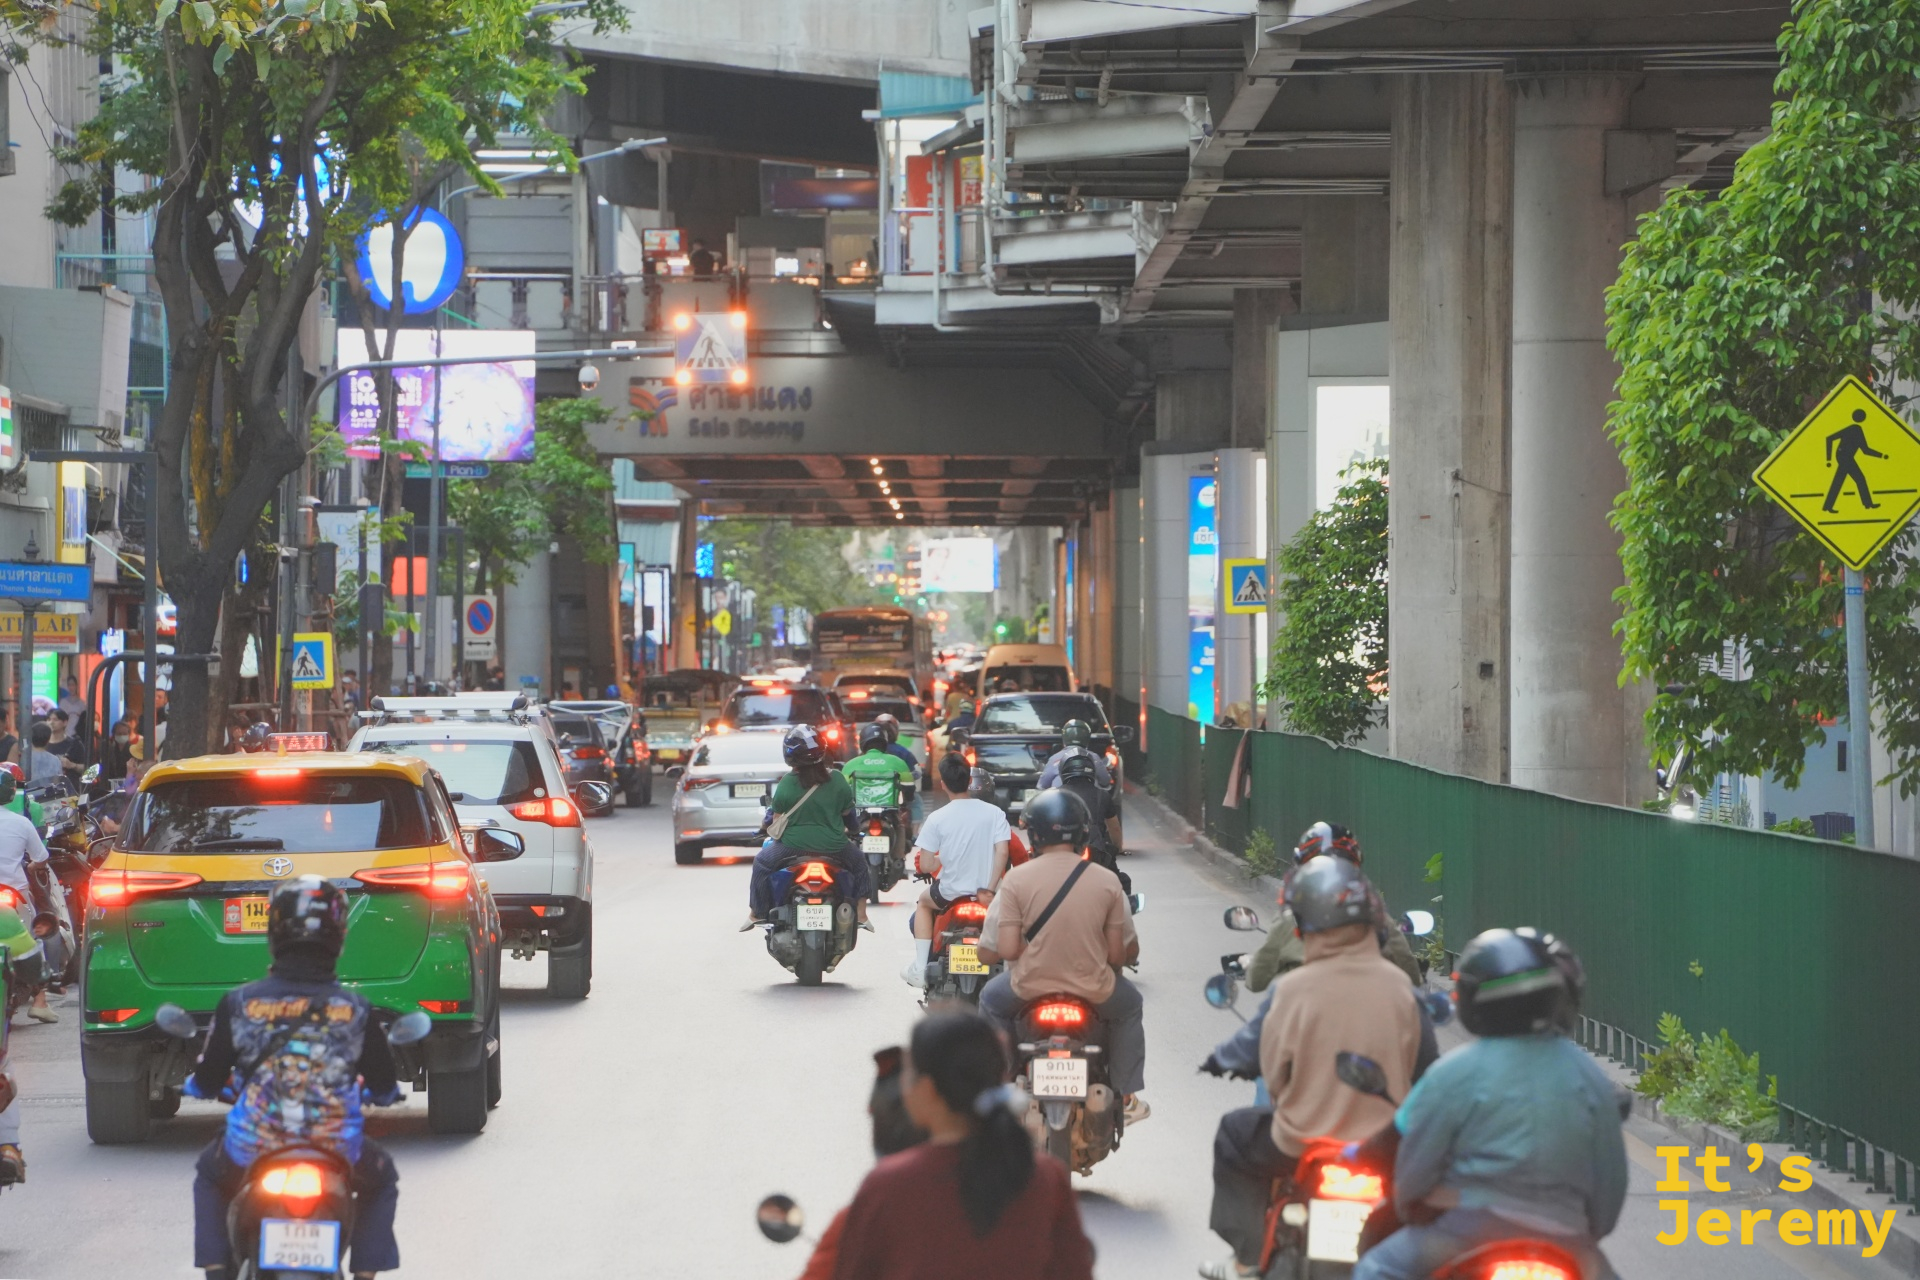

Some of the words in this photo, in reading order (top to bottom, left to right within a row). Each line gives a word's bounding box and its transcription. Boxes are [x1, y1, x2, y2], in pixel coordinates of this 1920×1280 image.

[274, 735, 324, 750] TAXI
[863, 757, 887, 766] Grab
[806, 920, 824, 928] 654
[955, 963, 983, 972] 5885
[1042, 1085, 1079, 1096] 4910
[274, 1251, 325, 1267] 2980
